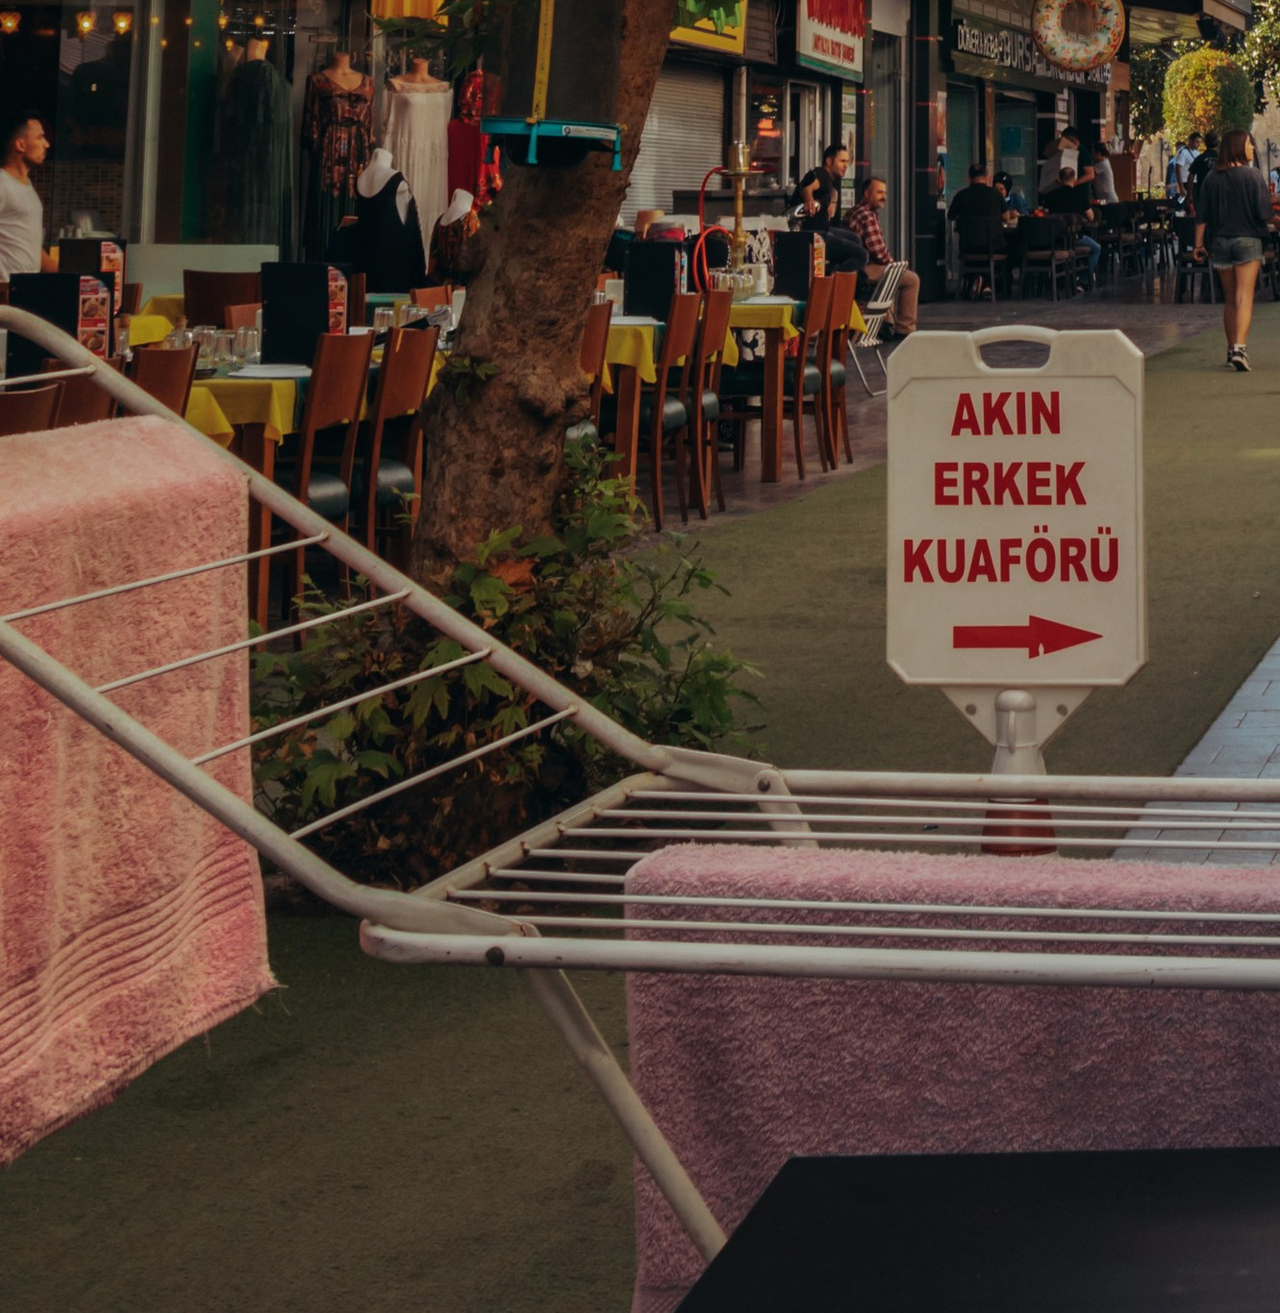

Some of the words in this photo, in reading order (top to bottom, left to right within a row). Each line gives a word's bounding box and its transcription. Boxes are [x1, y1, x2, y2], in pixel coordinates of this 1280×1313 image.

[951, 391, 1060, 436] AKIN
[934, 461, 1087, 506] ERKEK
[904, 525, 1119, 584] KUAFÖRÜ
